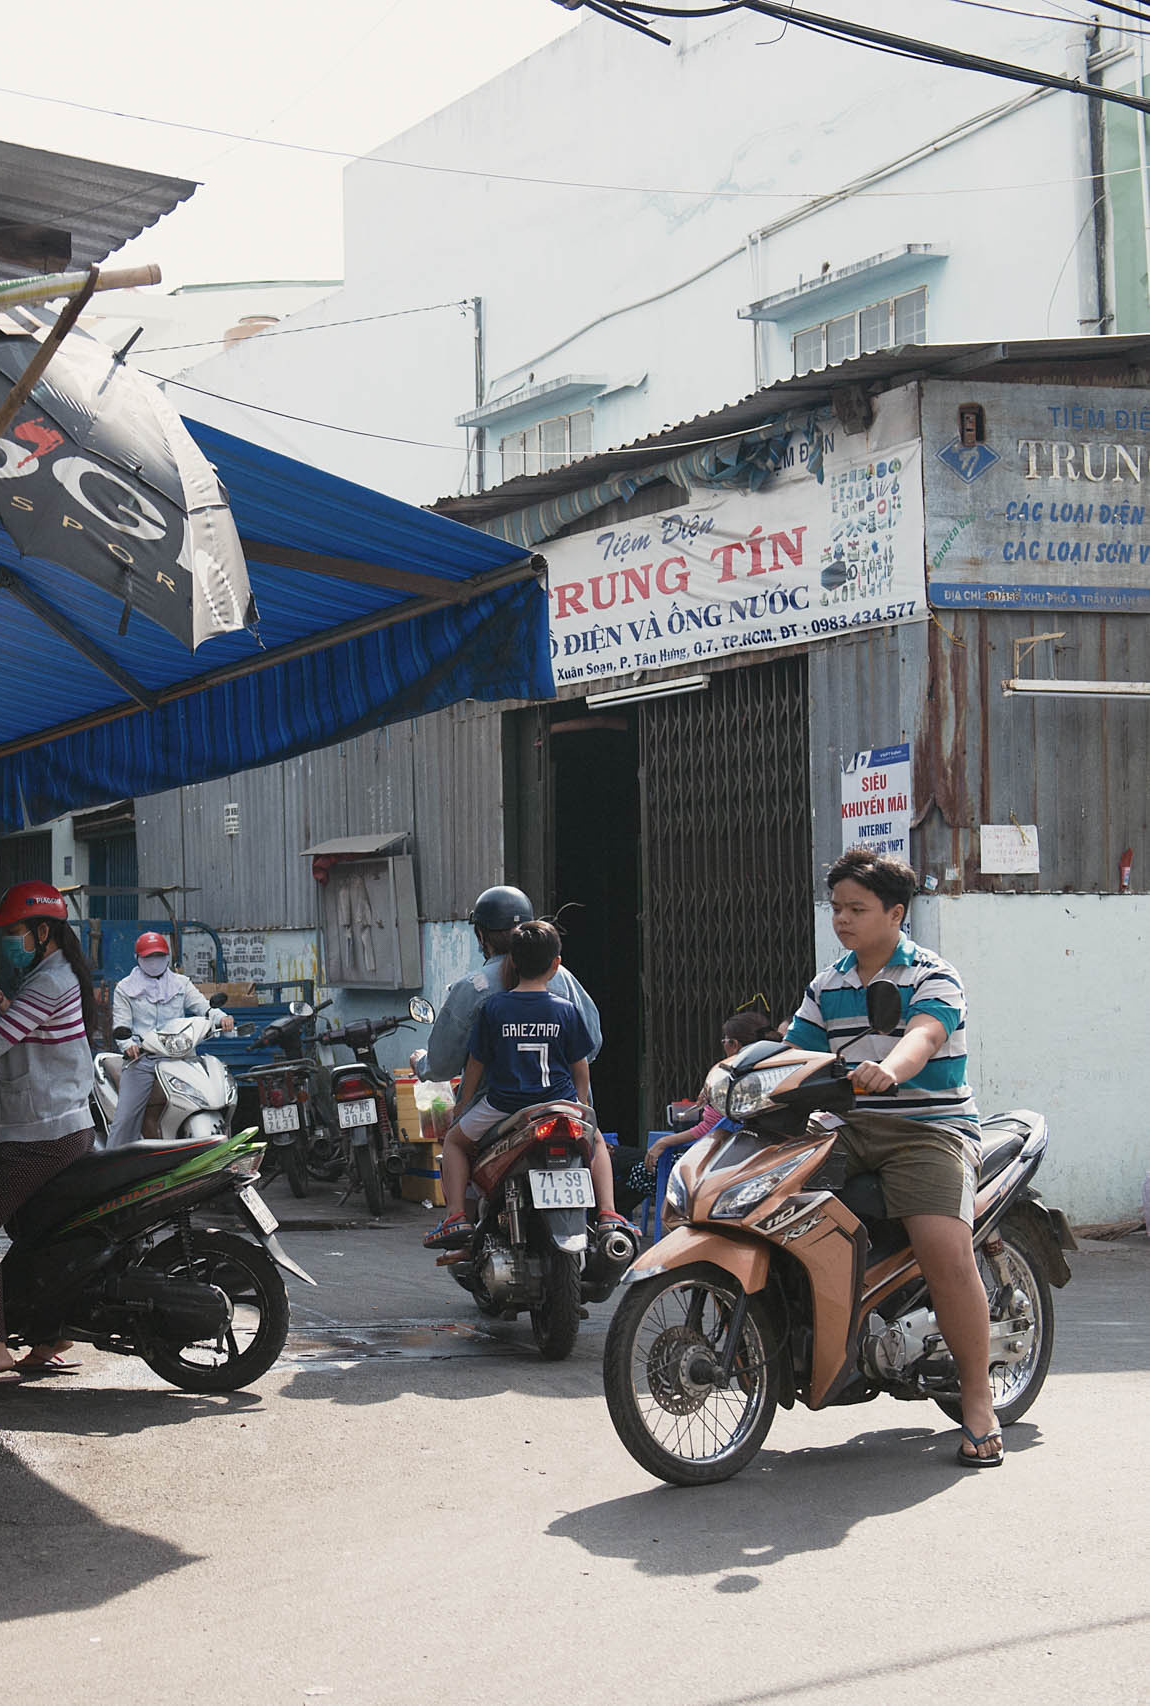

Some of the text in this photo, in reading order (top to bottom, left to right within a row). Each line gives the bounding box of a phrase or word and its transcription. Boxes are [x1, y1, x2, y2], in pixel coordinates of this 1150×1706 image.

[1018, 439, 1150, 483] TRUN
[1006, 494, 1043, 522] CÁC
[596, 514, 715, 562] Tiệm Điện
[1003, 532, 1040, 562] CÁC
[1047, 541, 1091, 566] LOẠI
[1095, 539, 1133, 564] SƠN
[548, 525, 807, 620] RUNG TÍN
[563, 623, 622, 657] ĐIỆN
[627, 610, 663, 643] VÀ
[667, 600, 722, 636] ỐNG
[728, 583, 810, 624] NƯỚC
[557, 666, 584, 681] Xuân
[586, 660, 617, 676] Soạn,
[620, 655, 631, 669] P.
[636, 652, 657, 667] Tân
[722, 628, 777, 649] TP.HCM,
[781, 623, 798, 640] ĐT
[811, 600, 917, 634] 0983.434.577
[861, 772, 887, 792] SIÊU
[842, 792, 908, 819] KHUYẾN MÃI
[858, 822, 892, 838] INTERNET
[517, 1043, 550, 1088] 7
[344, 1111, 372, 1127] 9048
[538, 1171, 583, 1188] 71-S9
[541, 1188, 586, 1207] 4438
[765, 1204, 796, 1230] 110
